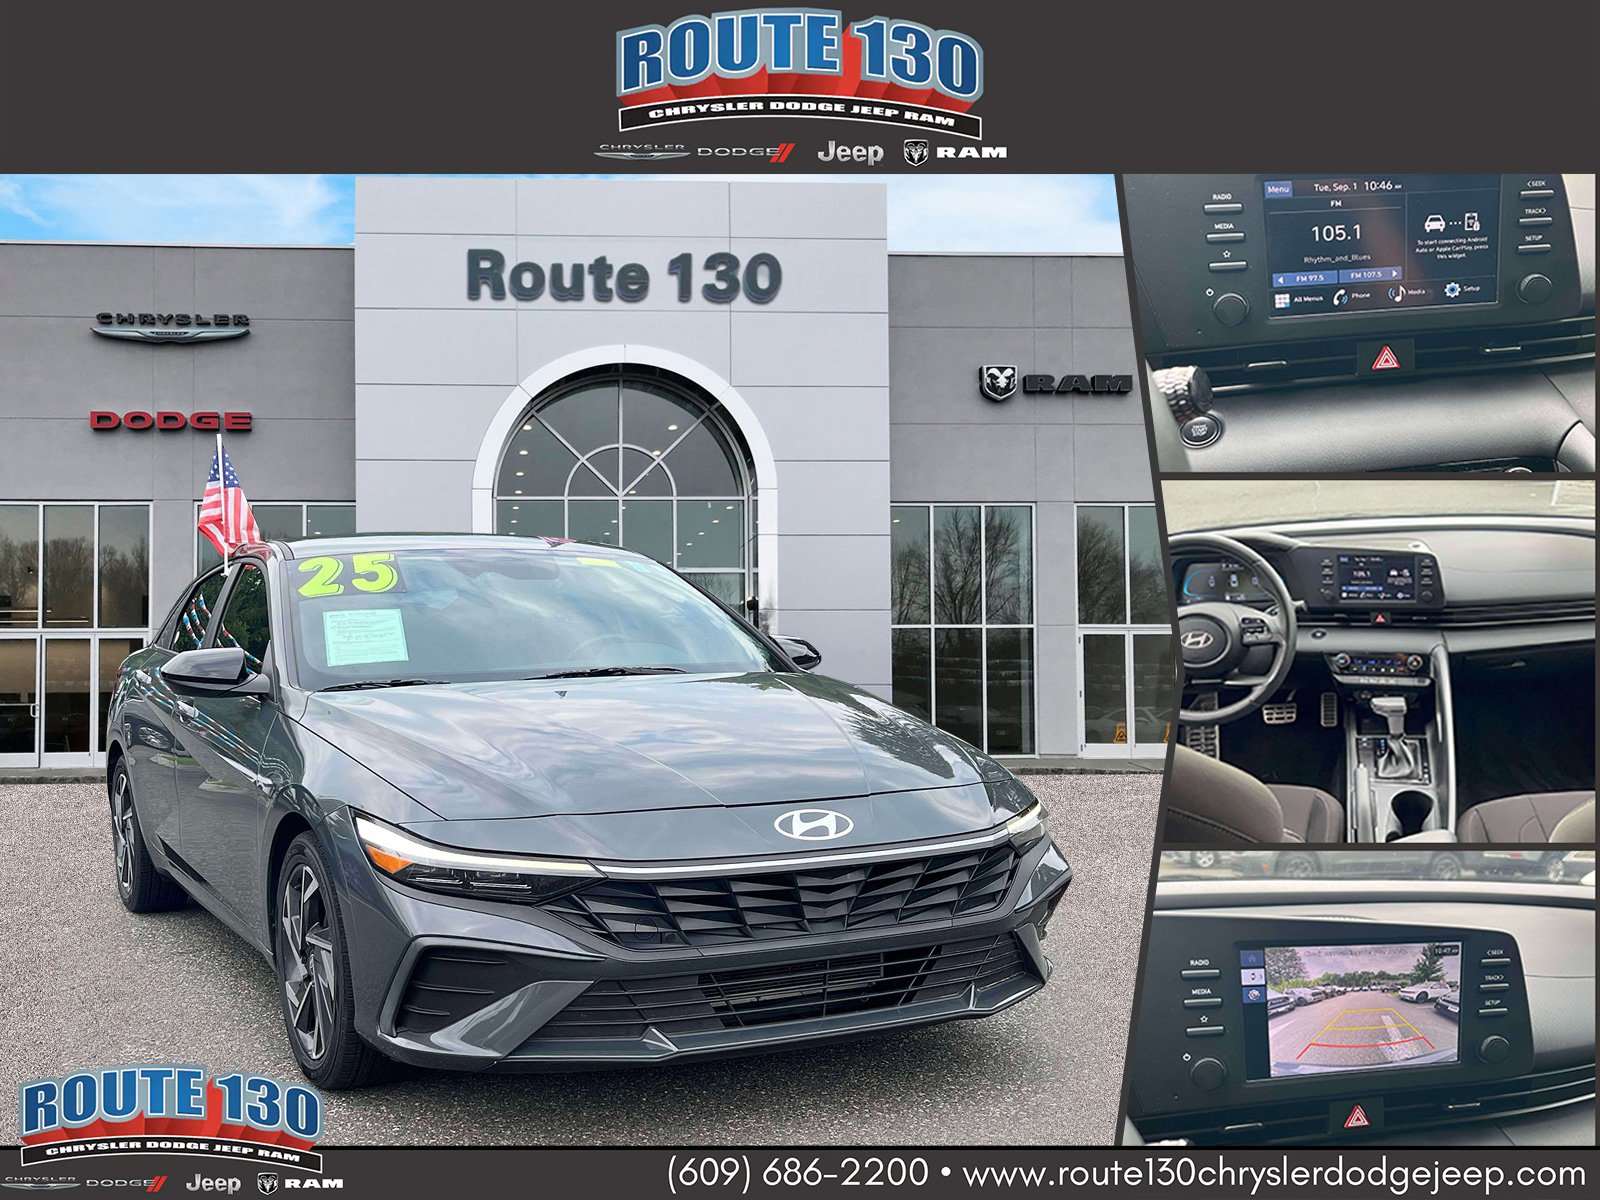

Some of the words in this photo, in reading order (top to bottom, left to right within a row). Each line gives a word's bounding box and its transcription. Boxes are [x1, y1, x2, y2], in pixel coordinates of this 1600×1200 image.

[1267, 185, 1290, 194] Menu
[1364, 181, 1393, 191] 10:46
[1311, 224, 1361, 242] 105.1
[1303, 254, 1371, 264] Rhythm_and_Blues
[467, 248, 650, 303] Route
[667, 251, 783, 304] 130
[96, 312, 250, 325] CHRYSLER
[1023, 374, 1133, 393] RAM
[90, 410, 252, 431] DODGE
[298, 553, 398, 597] 25
